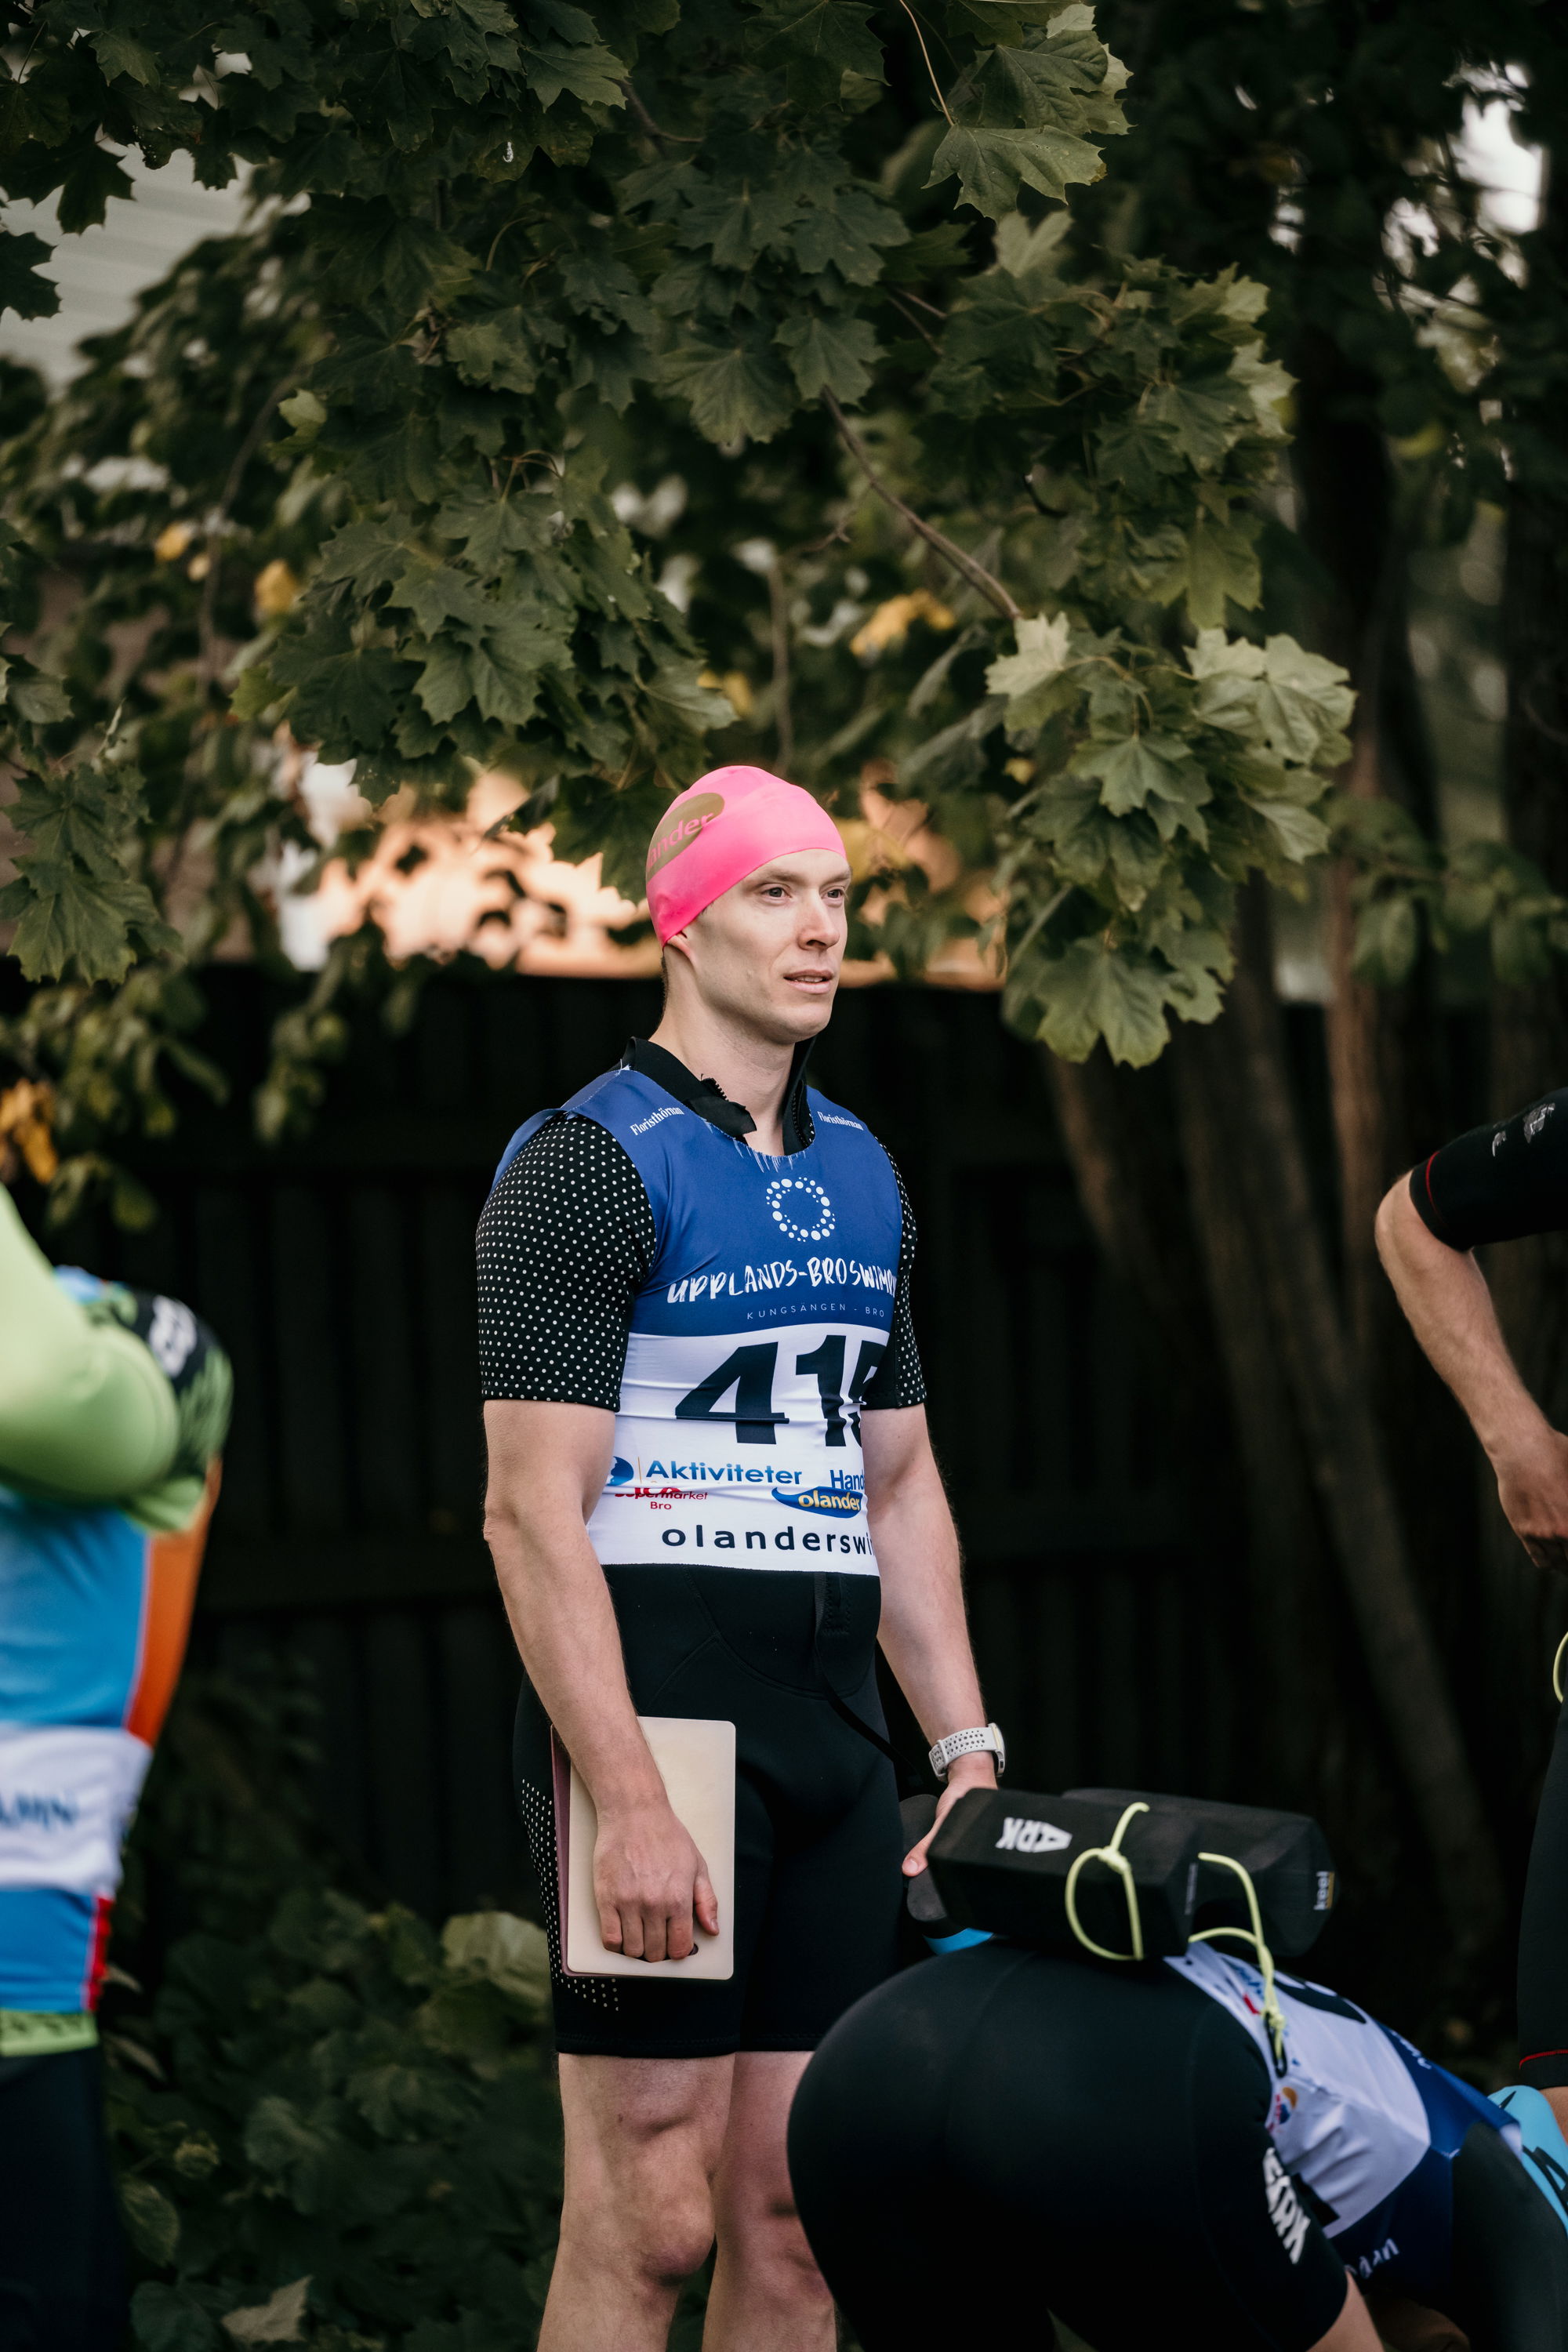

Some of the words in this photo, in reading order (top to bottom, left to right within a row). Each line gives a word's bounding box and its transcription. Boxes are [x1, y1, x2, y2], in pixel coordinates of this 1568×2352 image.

[647, 812, 714, 869] ander
[746, 1301, 846, 1320] KUNGSÄNGEN
[865, 1305, 884, 1318] BRO
[645, 1459, 803, 1485] Aktiviteter
[649, 1501, 673, 1510] Bro
[797, 1490, 861, 1511] olander
[661, 1524, 875, 1556] olanderswi
